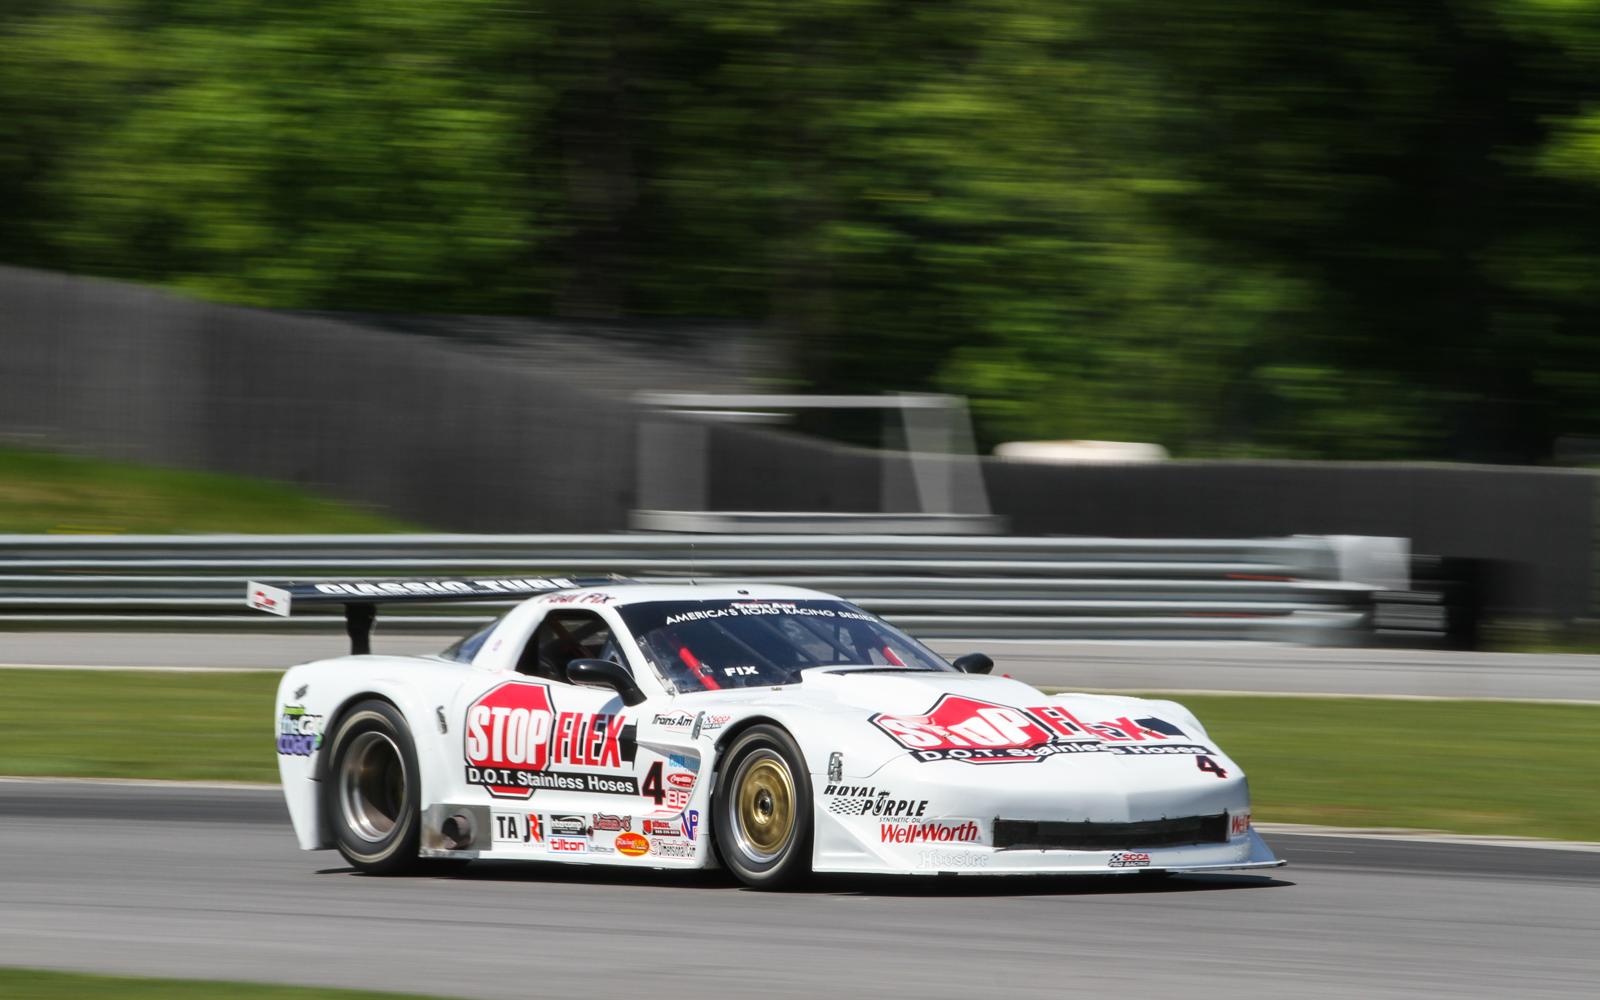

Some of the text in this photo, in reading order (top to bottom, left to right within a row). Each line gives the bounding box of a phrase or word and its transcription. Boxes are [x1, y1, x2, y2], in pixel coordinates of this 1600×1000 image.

[314, 581, 474, 595] CLASSIC
[666, 609, 737, 625] AMERICA'S
[741, 607, 779, 616] ROAD
[784, 606, 834, 618] RACING
[724, 665, 759, 677] FIX
[652, 714, 676, 726] Trans
[676, 716, 693, 727] Am
[879, 706, 1168, 747] STOP FLEX
[466, 705, 626, 768] STOP FLEX
[922, 748, 1002, 762] D.O.T.
[1130, 744, 1207, 756] Hoses
[1196, 755, 1227, 779] 4
[469, 767, 634, 793] D.O.T. Stainless Hoses
[642, 761, 666, 805] 4
[824, 784, 876, 798] ROYAL
[860, 799, 928, 817] PURPLE
[496, 816, 518, 839] TA
[681, 809, 699, 841] VP
[550, 838, 585, 851] tilton
[918, 851, 989, 869] Hoosier
[1122, 853, 1150, 861] SCCA
